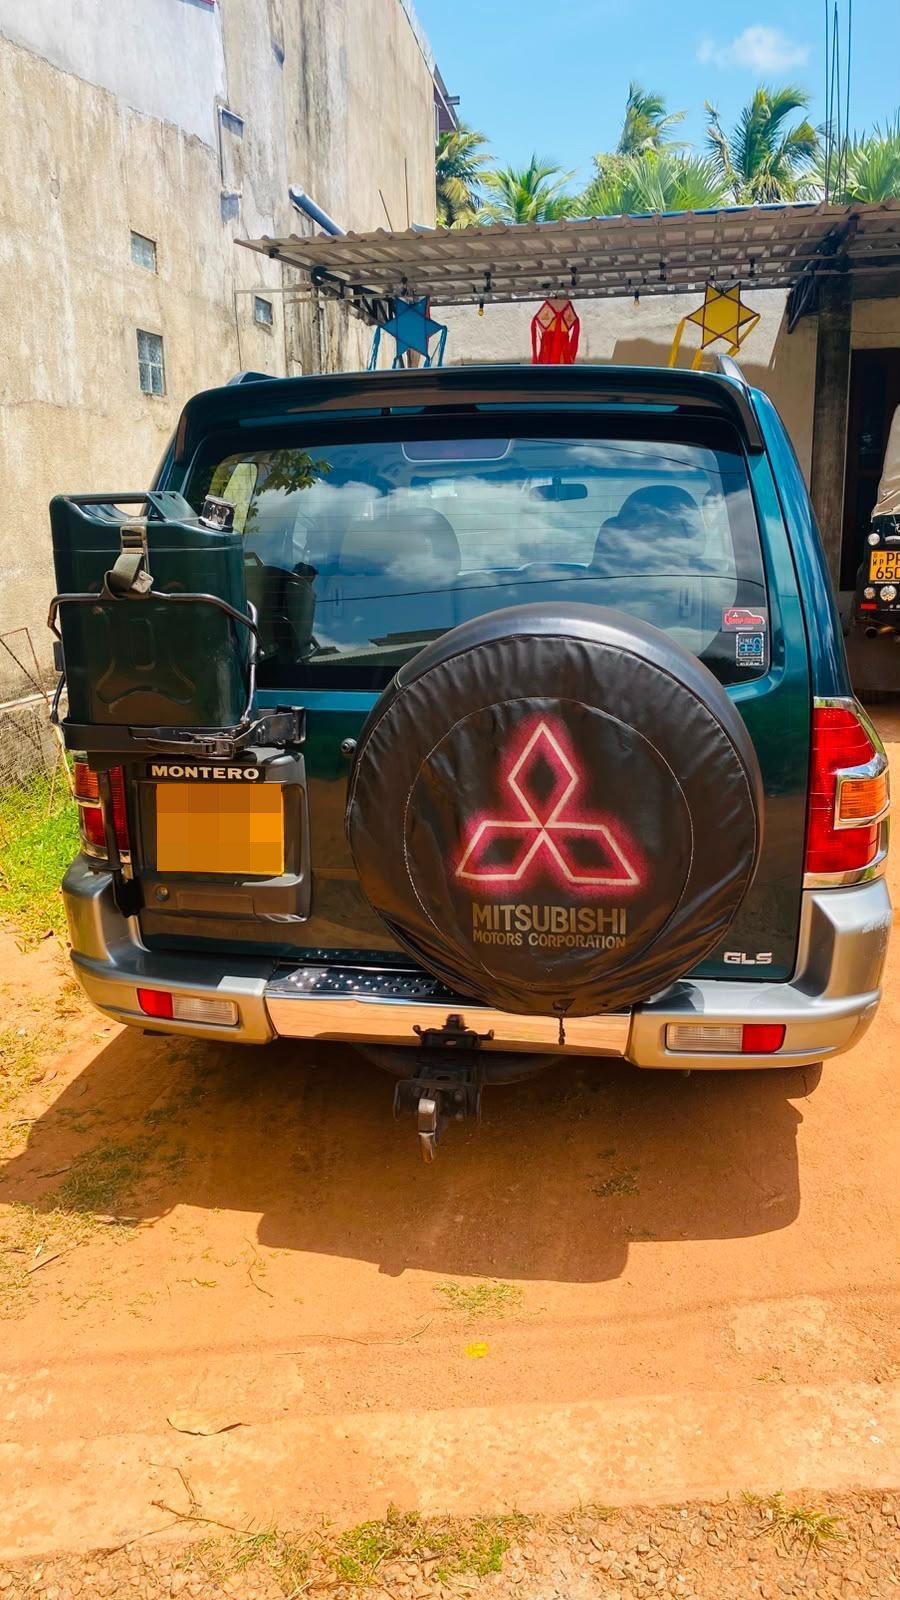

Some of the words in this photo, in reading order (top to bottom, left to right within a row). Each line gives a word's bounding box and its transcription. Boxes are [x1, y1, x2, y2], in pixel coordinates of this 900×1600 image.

[151, 765, 260, 780] MONTERO
[472, 902, 627, 935] MITSUBISHI
[472, 929, 523, 946] MOTORS
[528, 932, 626, 950] CORPORATION
[723, 951, 773, 965] GLS
